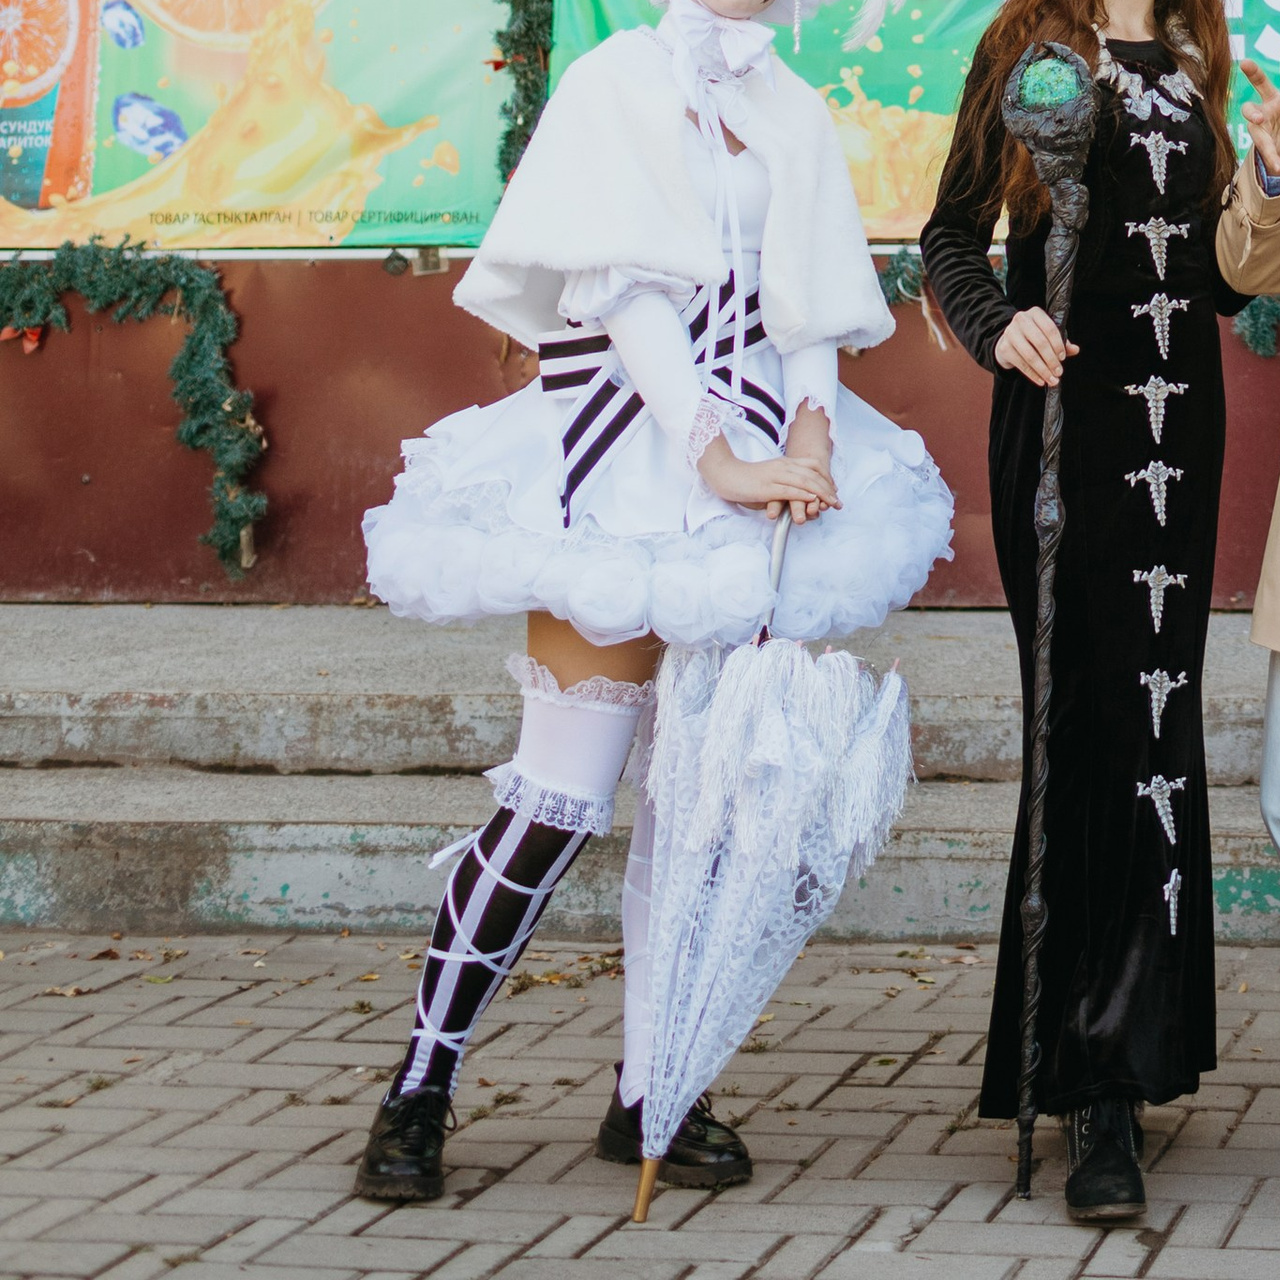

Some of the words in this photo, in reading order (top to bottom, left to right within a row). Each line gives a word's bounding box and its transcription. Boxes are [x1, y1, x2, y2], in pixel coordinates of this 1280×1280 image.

[149, 211, 189, 225] ТОВАР
[192, 211, 292, 225] ТАСТЫКТАЛГАН
[308, 210, 349, 223] ТОВАР
[351, 209, 479, 224] СЕРТИФИЦИРОВАН
